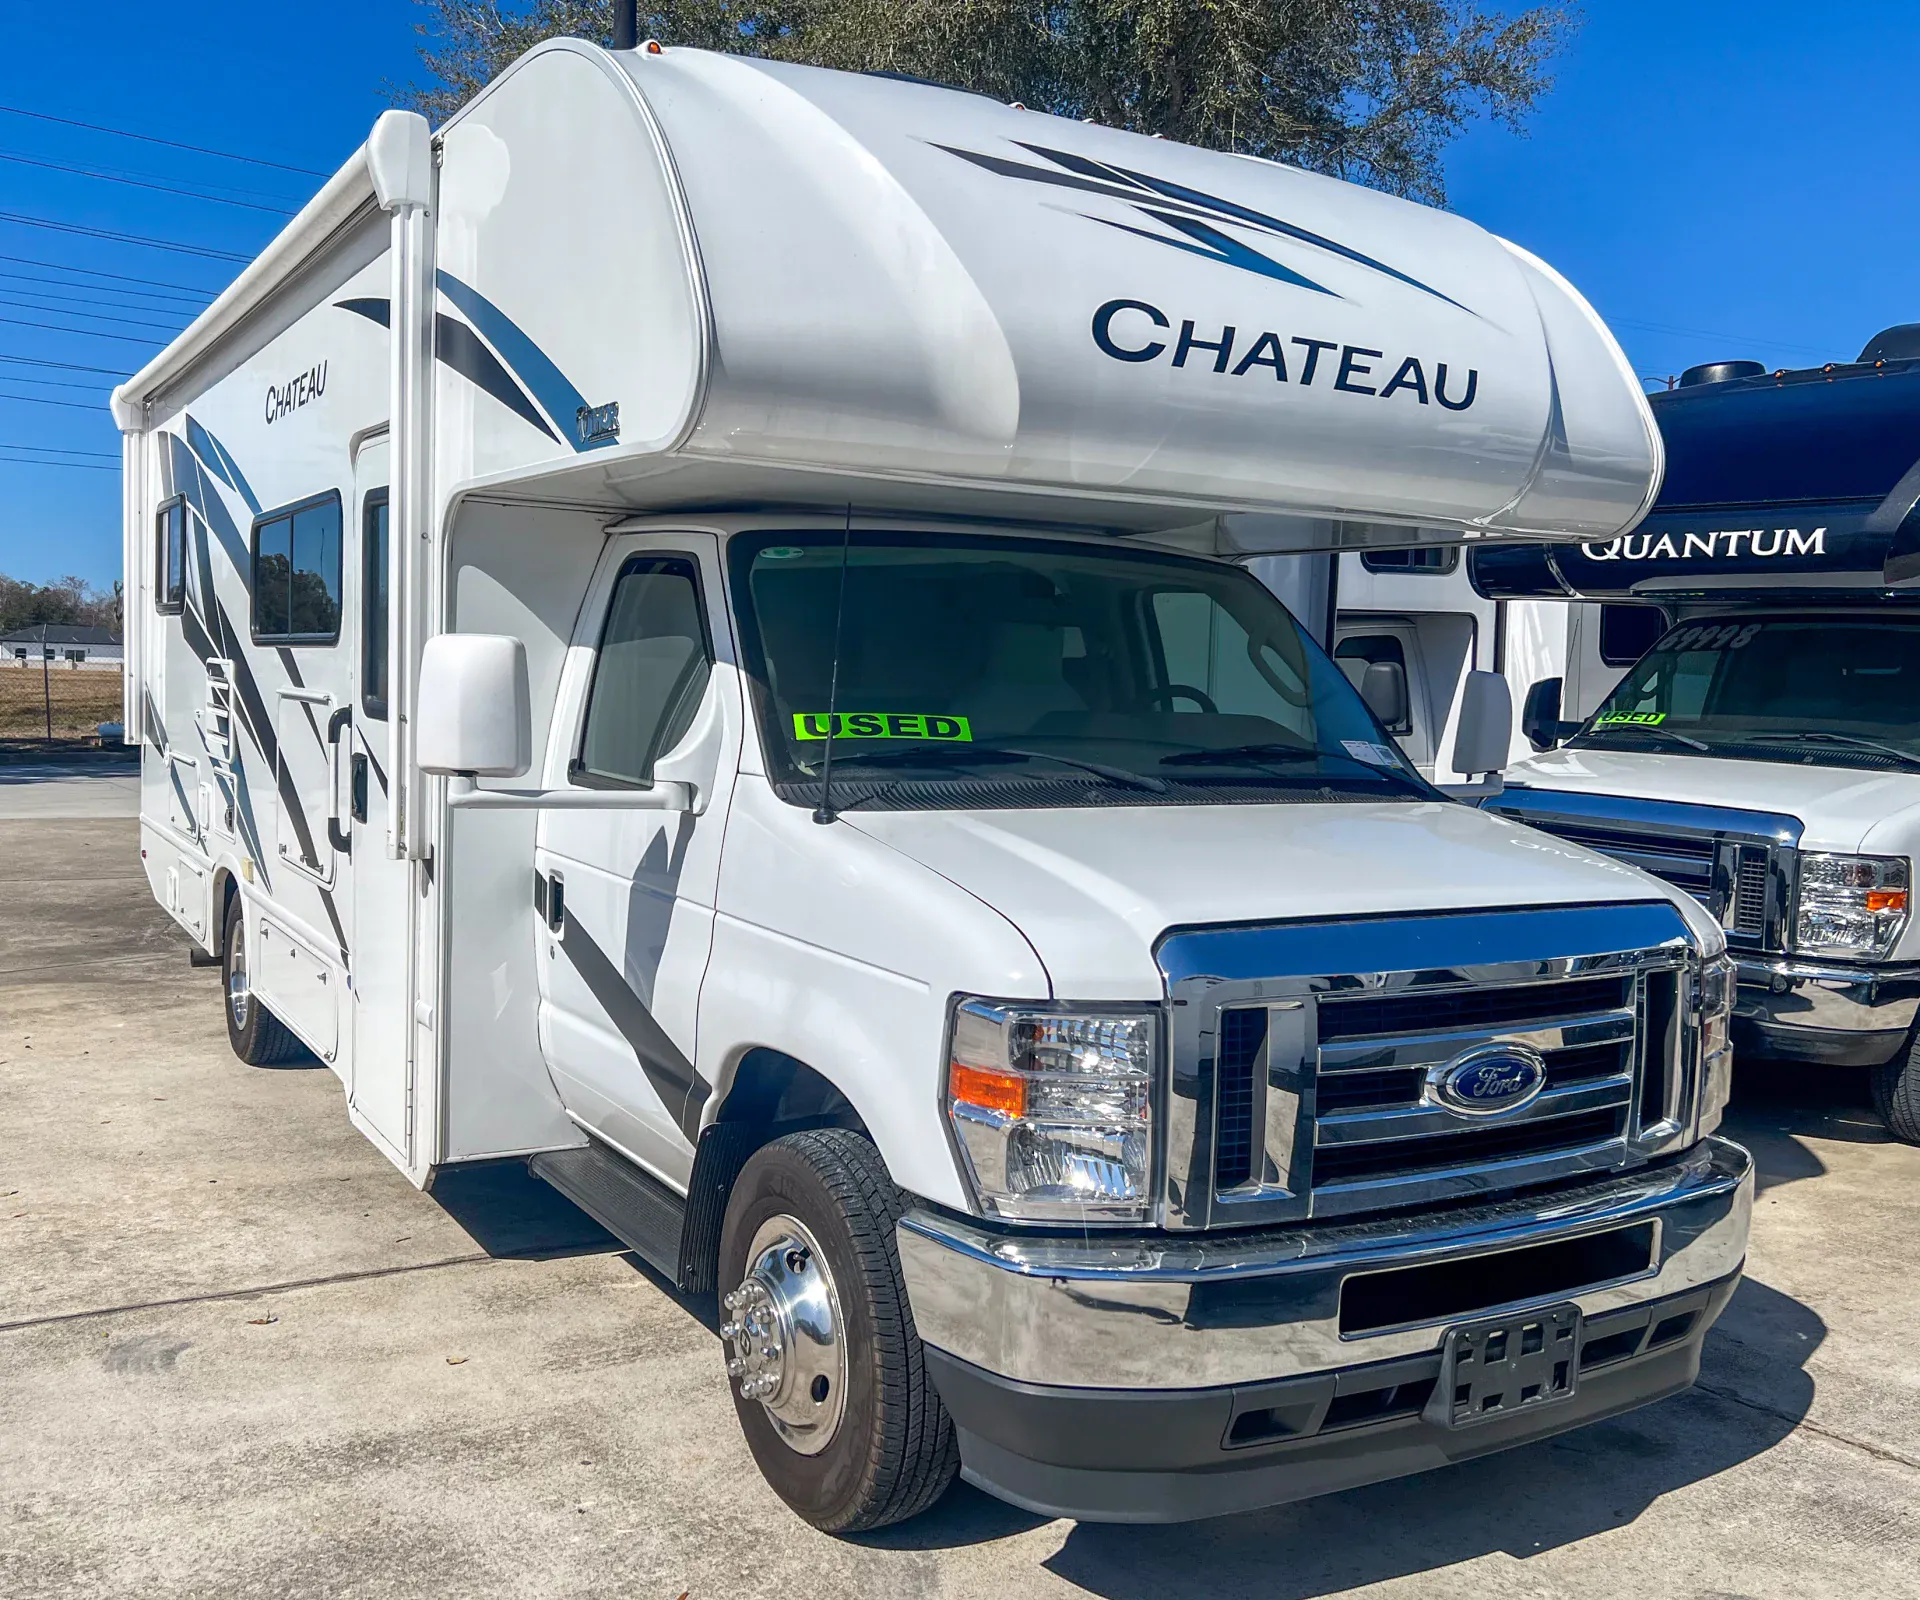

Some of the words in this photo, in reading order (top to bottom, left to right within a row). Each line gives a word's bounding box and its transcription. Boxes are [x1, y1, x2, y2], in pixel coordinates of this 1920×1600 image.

[1091, 298, 1478, 411] CHATEAU
[265, 359, 328, 425] CHATEAU
[1581, 527, 1828, 561] QUANTUM
[1656, 623, 1762, 651] 69998
[802, 714, 962, 738] USED
[1603, 711, 1660, 723] USED
[1473, 1065, 1523, 1097] Ford
